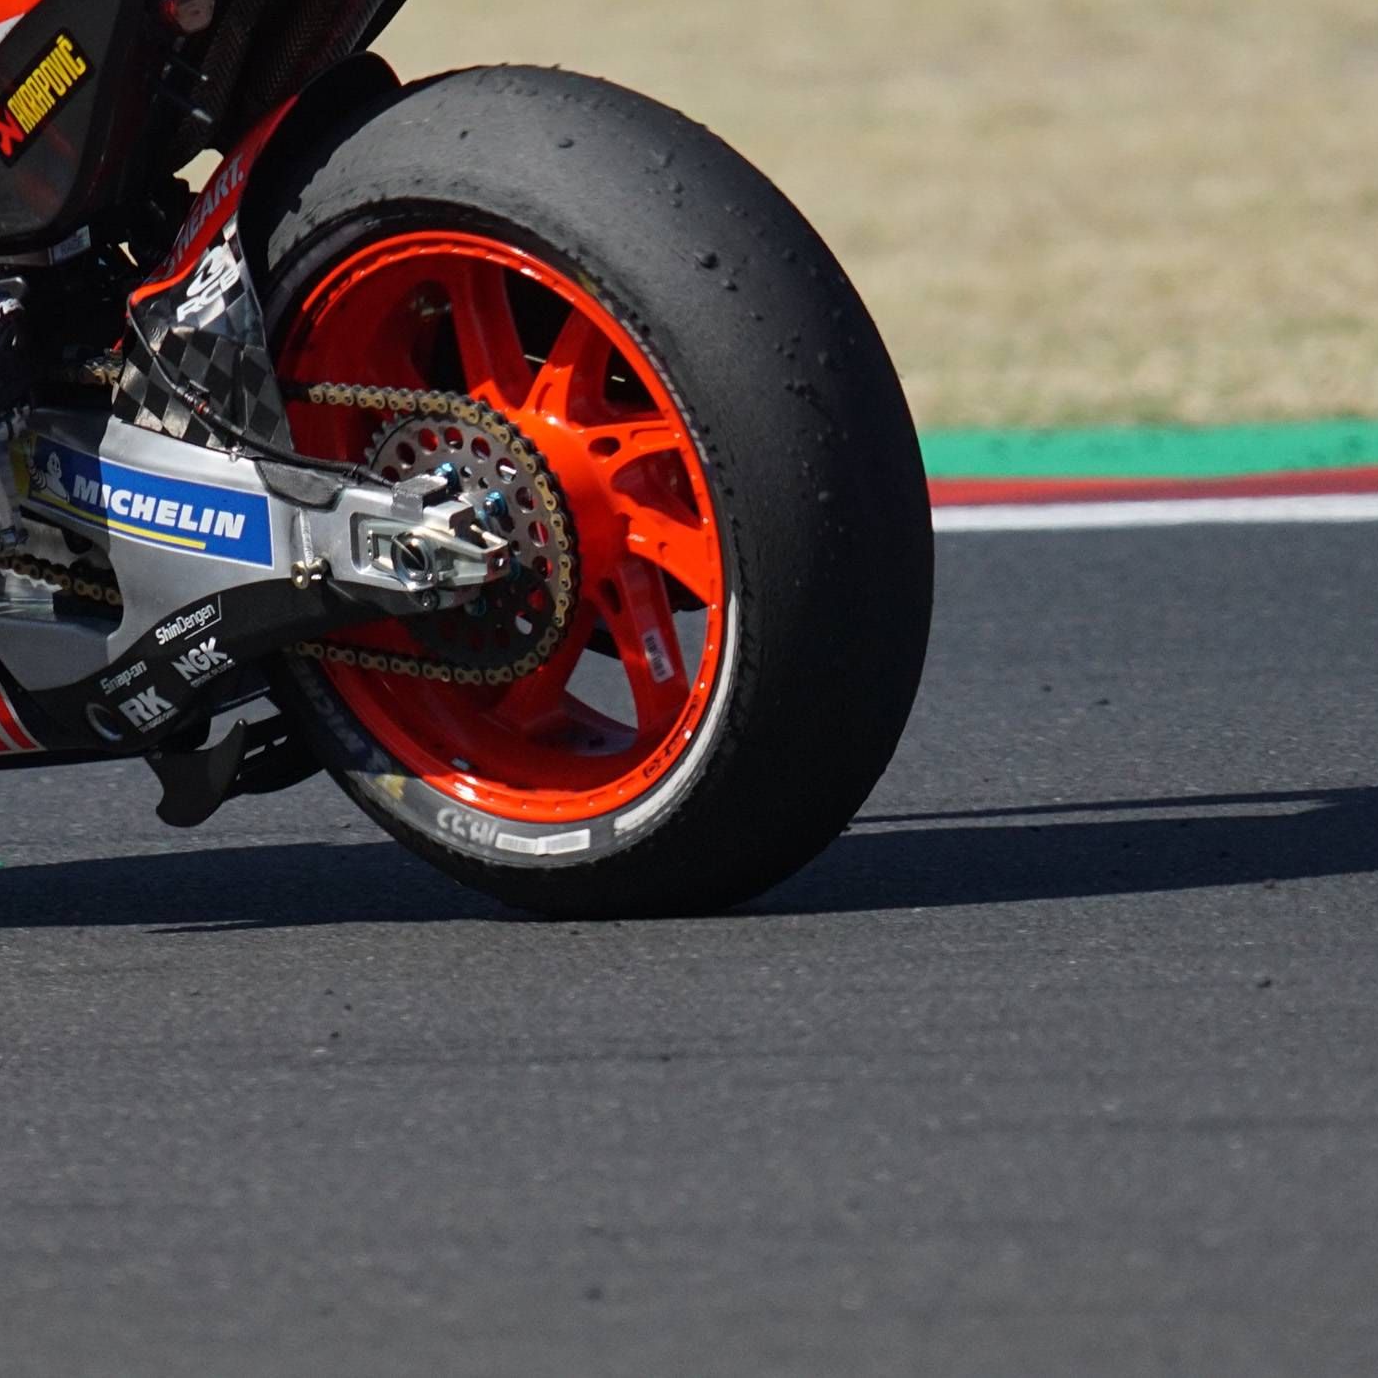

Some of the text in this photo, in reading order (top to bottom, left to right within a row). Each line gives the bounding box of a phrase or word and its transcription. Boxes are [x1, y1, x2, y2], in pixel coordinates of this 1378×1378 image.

[73, 474, 245, 540] MICHELIN
[155, 603, 215, 645] ShinDengen
[171, 636, 227, 681] NGK
[118, 685, 174, 728] RK
